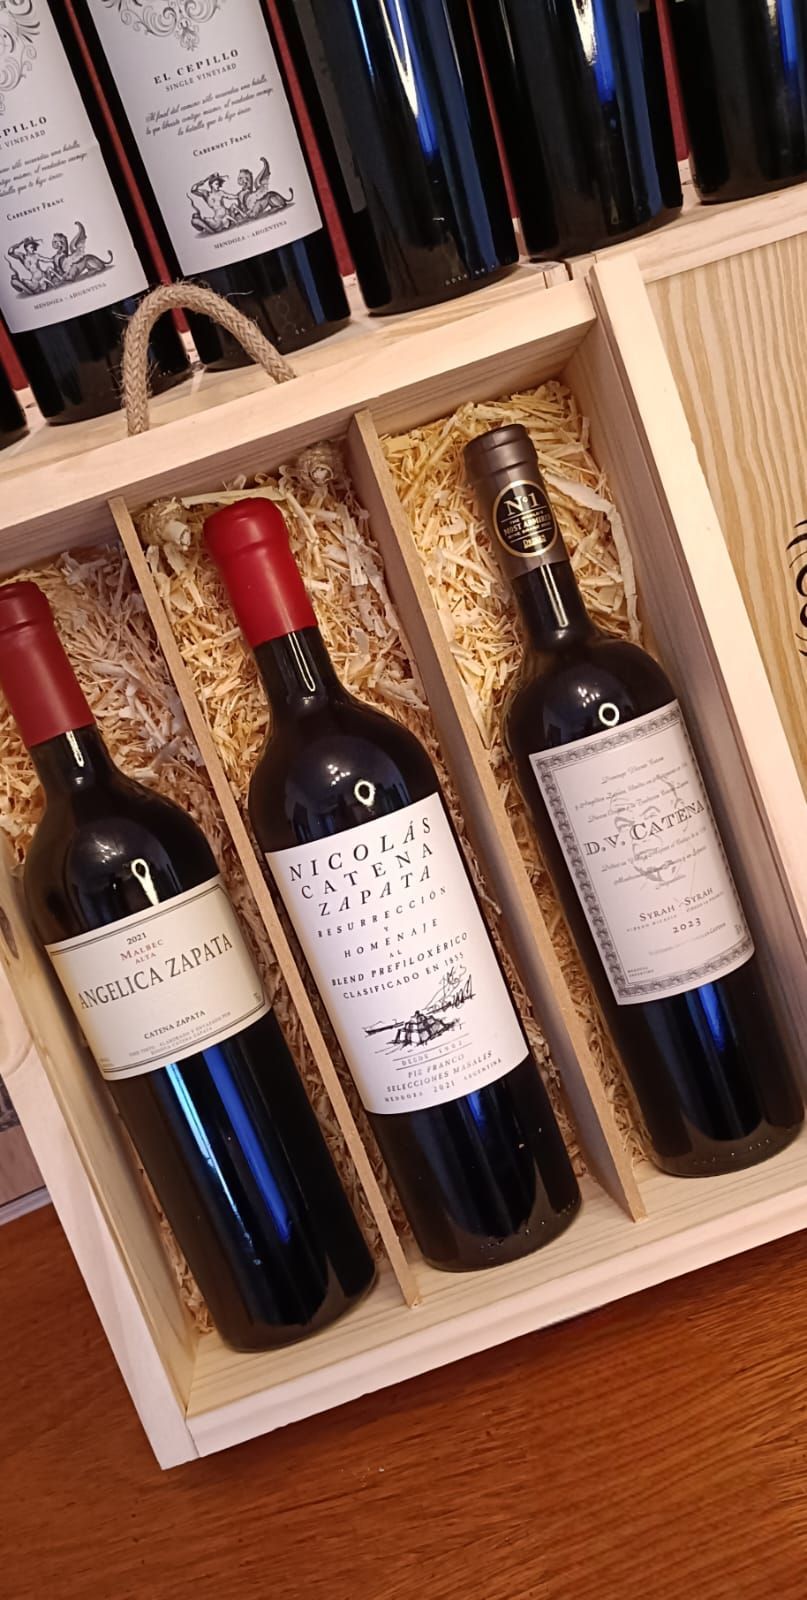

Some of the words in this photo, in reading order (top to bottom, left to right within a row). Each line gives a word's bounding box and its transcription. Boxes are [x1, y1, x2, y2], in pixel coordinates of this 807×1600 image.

[154, 73, 171, 84] EL
[176, 49, 240, 76] CEPILLO
[165, 78, 194, 92] SINGLE
[197, 63, 237, 81] VINEYARD
[4, 130, 46, 148] VINEYARD
[193, 141, 228, 157] CABERNET
[230, 132, 252, 145] FRANC
[6, 205, 40, 221] CABERNET
[42, 198, 64, 211] FRANC
[504, 522, 522, 536] MOST
[584, 835, 627, 856] D.V.
[629, 800, 705, 841] CATENA
[289, 817, 431, 882] NICOLÁS
[301, 843, 433, 900] CATENA
[319, 865, 431, 917] ZAPATA
[640, 904, 676, 922] SYRAH
[684, 888, 714, 906] SYRAH
[126, 932, 147, 945] 2021
[344, 918, 438, 958] HOMENAJE
[672, 918, 702, 934] 2023
[120, 938, 164, 962] MALBEC
[135, 952, 156, 965] ALTA
[389, 950, 403, 958] AL
[78, 967, 164, 1010] ANGELICA
[165, 933, 232, 978] ZAPATA
[331, 972, 365, 987] BLEND
[343, 971, 420, 1000] CLASIFICADO
[426, 964, 440, 976] EN
[444, 951, 465, 966] 1855
[144, 1024, 175, 1040] CATENA
[176, 1010, 206, 1028] ZAPATA
[386, 1070, 449, 1092] SELECCIONES
[452, 1050, 492, 1074] MASALES
[408, 1068, 422, 1078] PIE
[427, 1053, 465, 1073] FRANCO
[433, 1080, 456, 1093] 2021
